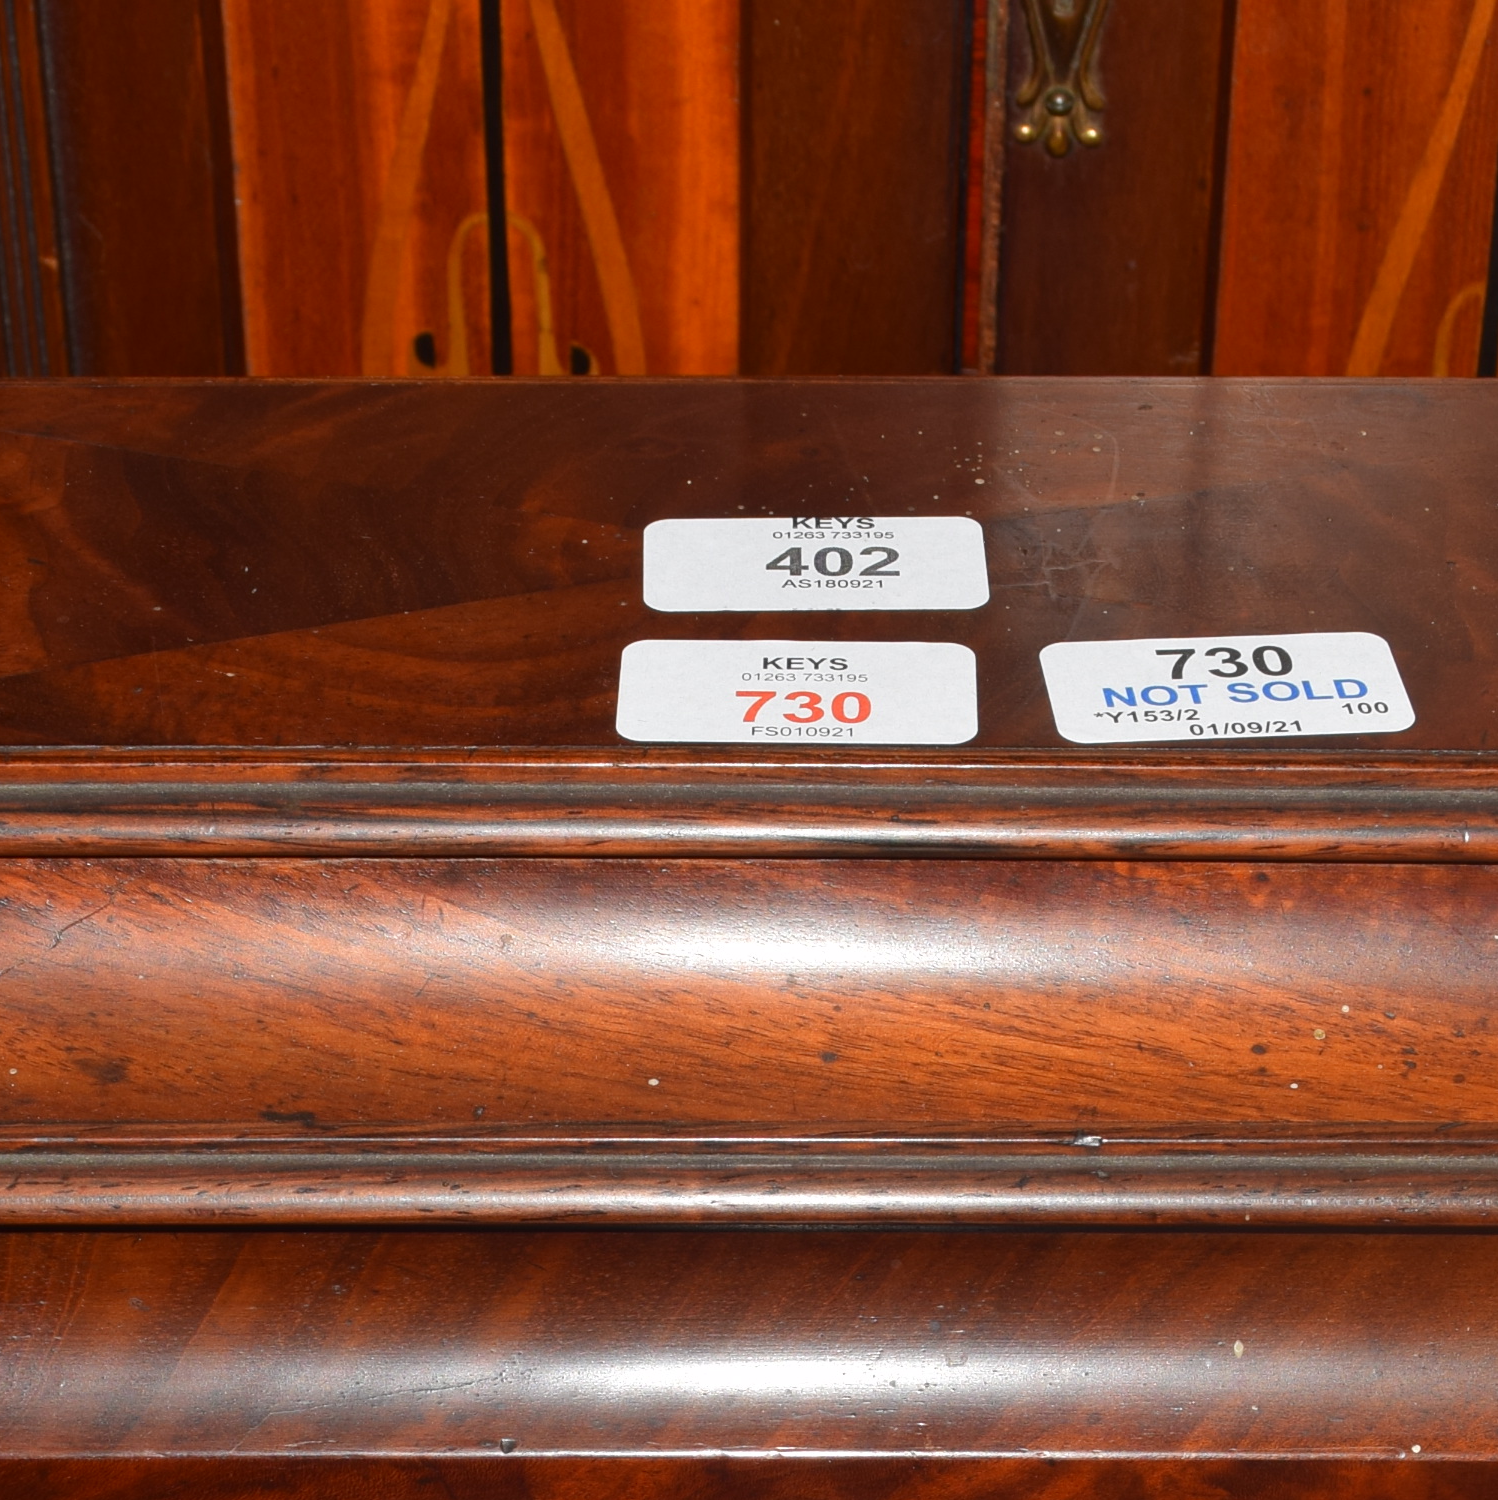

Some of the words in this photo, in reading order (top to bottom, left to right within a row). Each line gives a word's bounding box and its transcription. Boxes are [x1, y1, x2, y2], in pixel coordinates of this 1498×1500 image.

[790, 515, 876, 529] KEYS
[772, 531, 826, 540] 01263
[830, 531, 895, 540] 733195
[765, 546, 901, 577] 402
[781, 578, 884, 589] AS180921
[762, 656, 849, 671] KEYS
[1154, 645, 1293, 680] 730
[741, 672, 797, 682] 01263
[803, 672, 869, 683] 733195
[1103, 683, 1209, 709] NOT
[1226, 678, 1368, 704] SOLD
[735, 690, 872, 724] 730
[1341, 701, 1389, 715] 100
[751, 725, 855, 739] FS010921
[1188, 720, 1303, 737] 01/09/21
